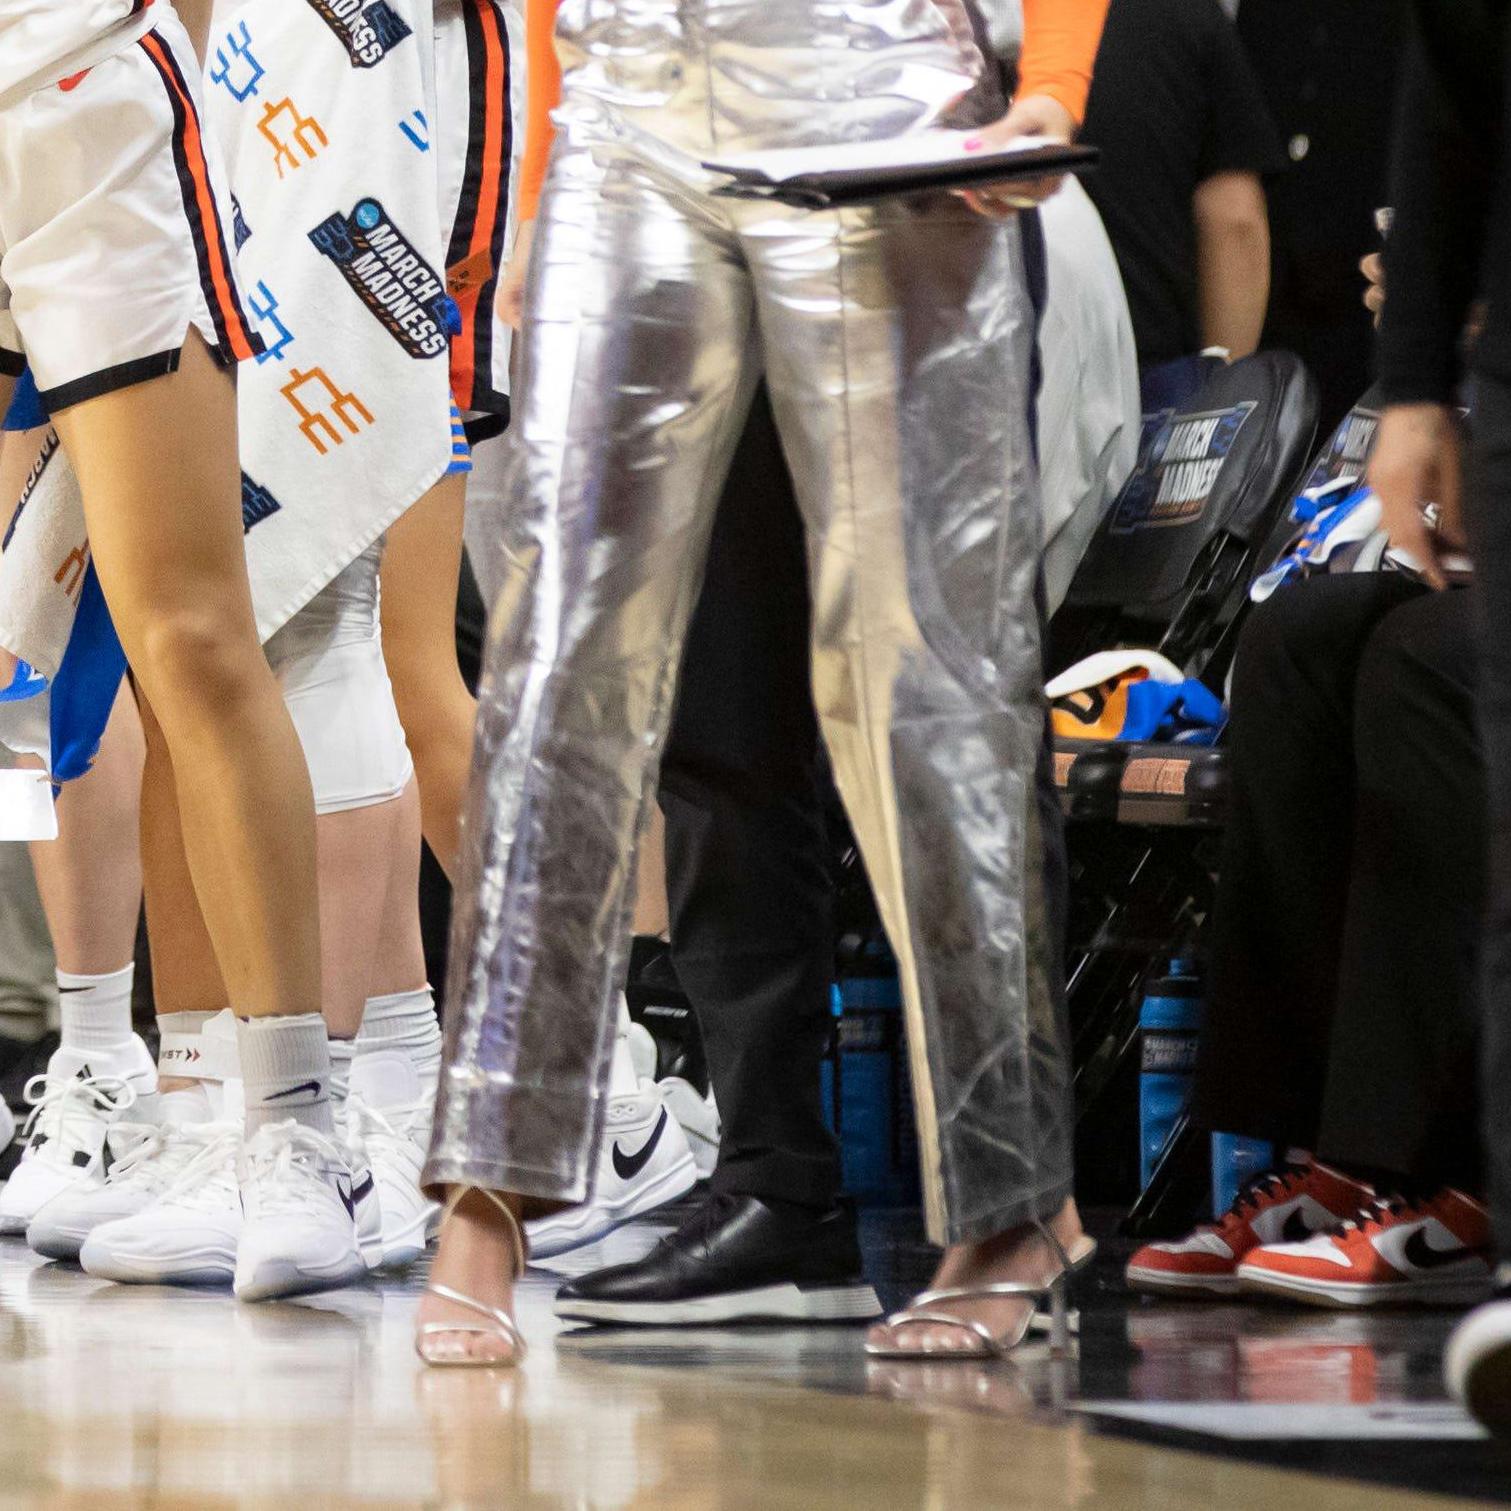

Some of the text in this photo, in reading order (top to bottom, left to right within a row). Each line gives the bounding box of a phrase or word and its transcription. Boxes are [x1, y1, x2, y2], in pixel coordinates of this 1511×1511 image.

[351, 250, 447, 355] MADNESS
[364, 223, 442, 304] MARCH
[1161, 417, 1221, 463] MARCH
